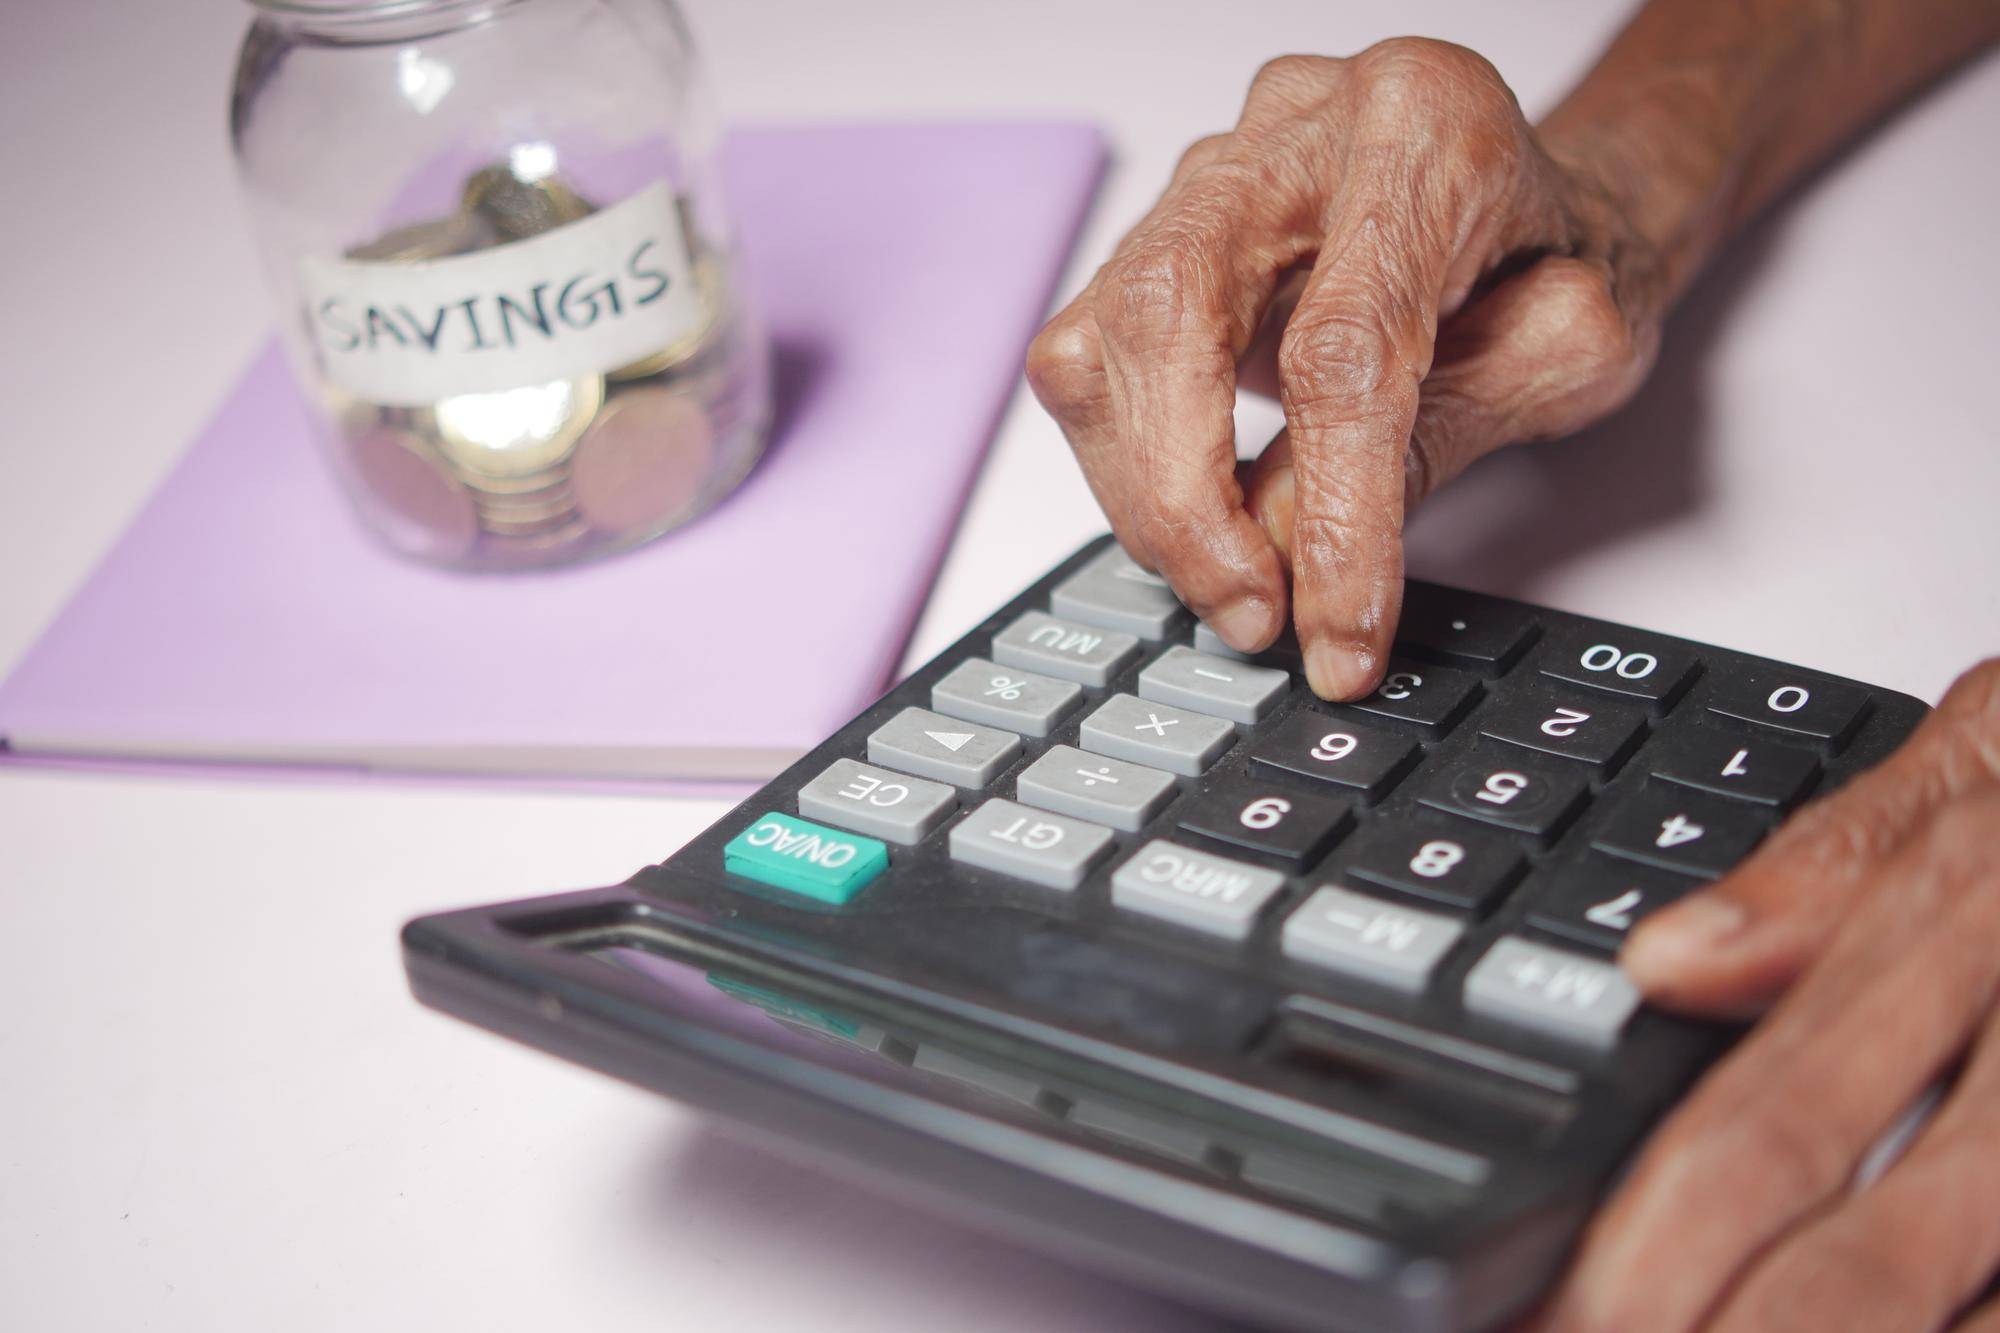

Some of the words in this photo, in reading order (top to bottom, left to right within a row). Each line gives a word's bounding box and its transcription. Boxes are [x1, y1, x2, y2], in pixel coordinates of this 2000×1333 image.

[318, 240, 671, 352] SAVINGS
[1028, 625, 1102, 655] MU
[1580, 644, 1658, 679] 00
[984, 675, 1025, 701] %
[1378, 672, 1422, 700] 3
[1766, 686, 1810, 713] 0
[1540, 707, 1590, 736] 2
[1310, 732, 1358, 761] 6
[1720, 748, 1750, 776] 1
[838, 774, 910, 807] CE
[1475, 771, 1530, 805] 5
[1239, 797, 1292, 829] 9
[747, 822, 857, 867] ON/AC
[990, 817, 1065, 850] GT
[1655, 814, 1704, 849] 4
[1409, 841, 1465, 878] 8
[1141, 854, 1252, 902] MRC
[1584, 889, 1642, 930] 7
